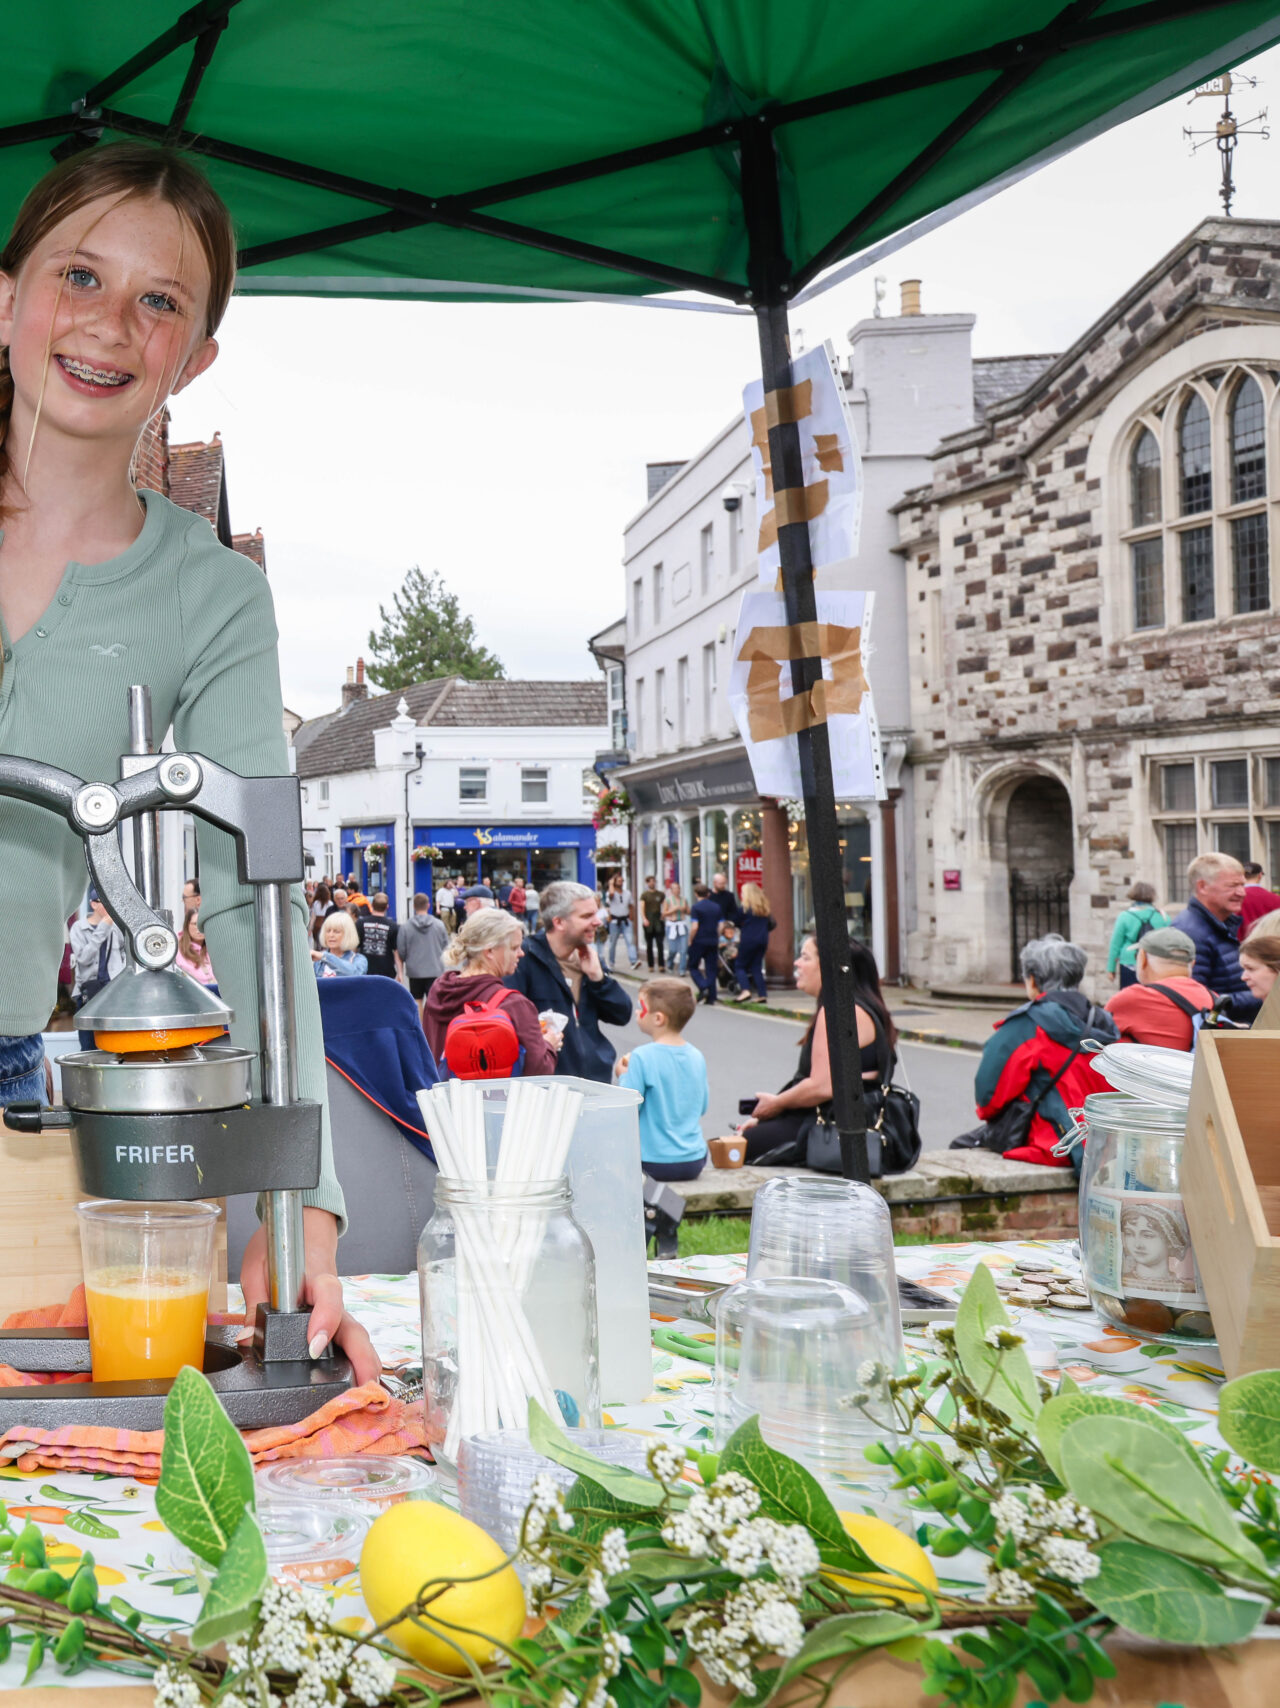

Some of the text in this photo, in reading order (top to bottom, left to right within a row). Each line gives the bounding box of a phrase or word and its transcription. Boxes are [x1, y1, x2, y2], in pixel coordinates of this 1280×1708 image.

[481, 828, 539, 845] Salamander
[738, 857, 763, 872] SALE
[115, 1145, 195, 1164] FRIFER
